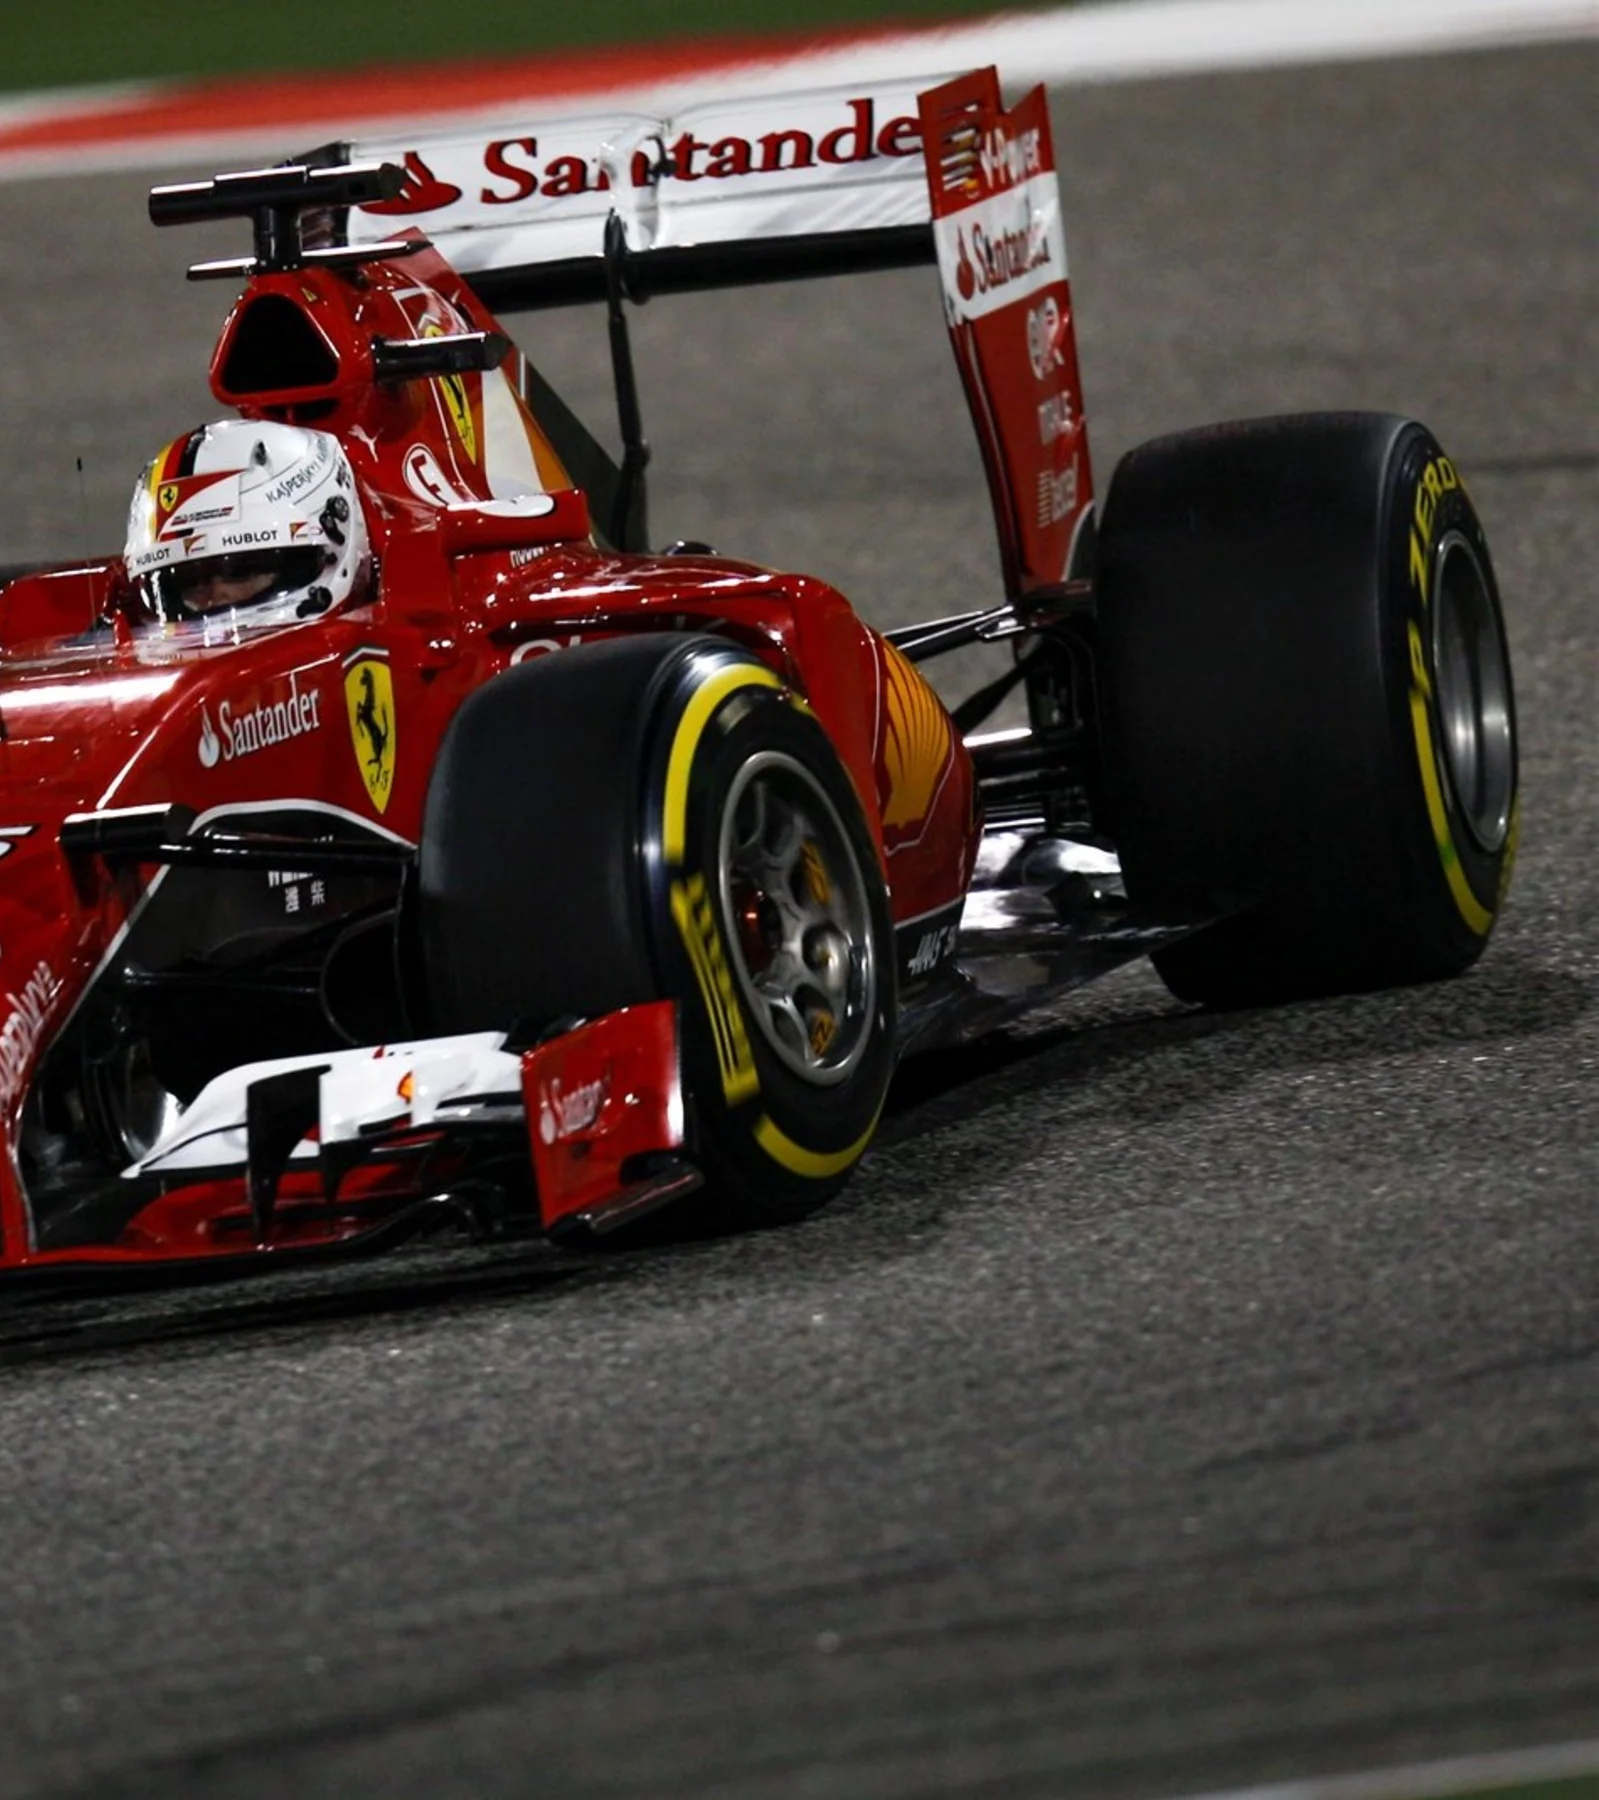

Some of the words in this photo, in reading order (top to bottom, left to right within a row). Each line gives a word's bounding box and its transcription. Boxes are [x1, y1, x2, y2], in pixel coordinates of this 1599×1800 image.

[480, 97, 925, 204] Santande
[135, 547, 171, 567] HUBLOT
[221, 529, 279, 547] HUBLOT
[219, 671, 321, 762] Santander
